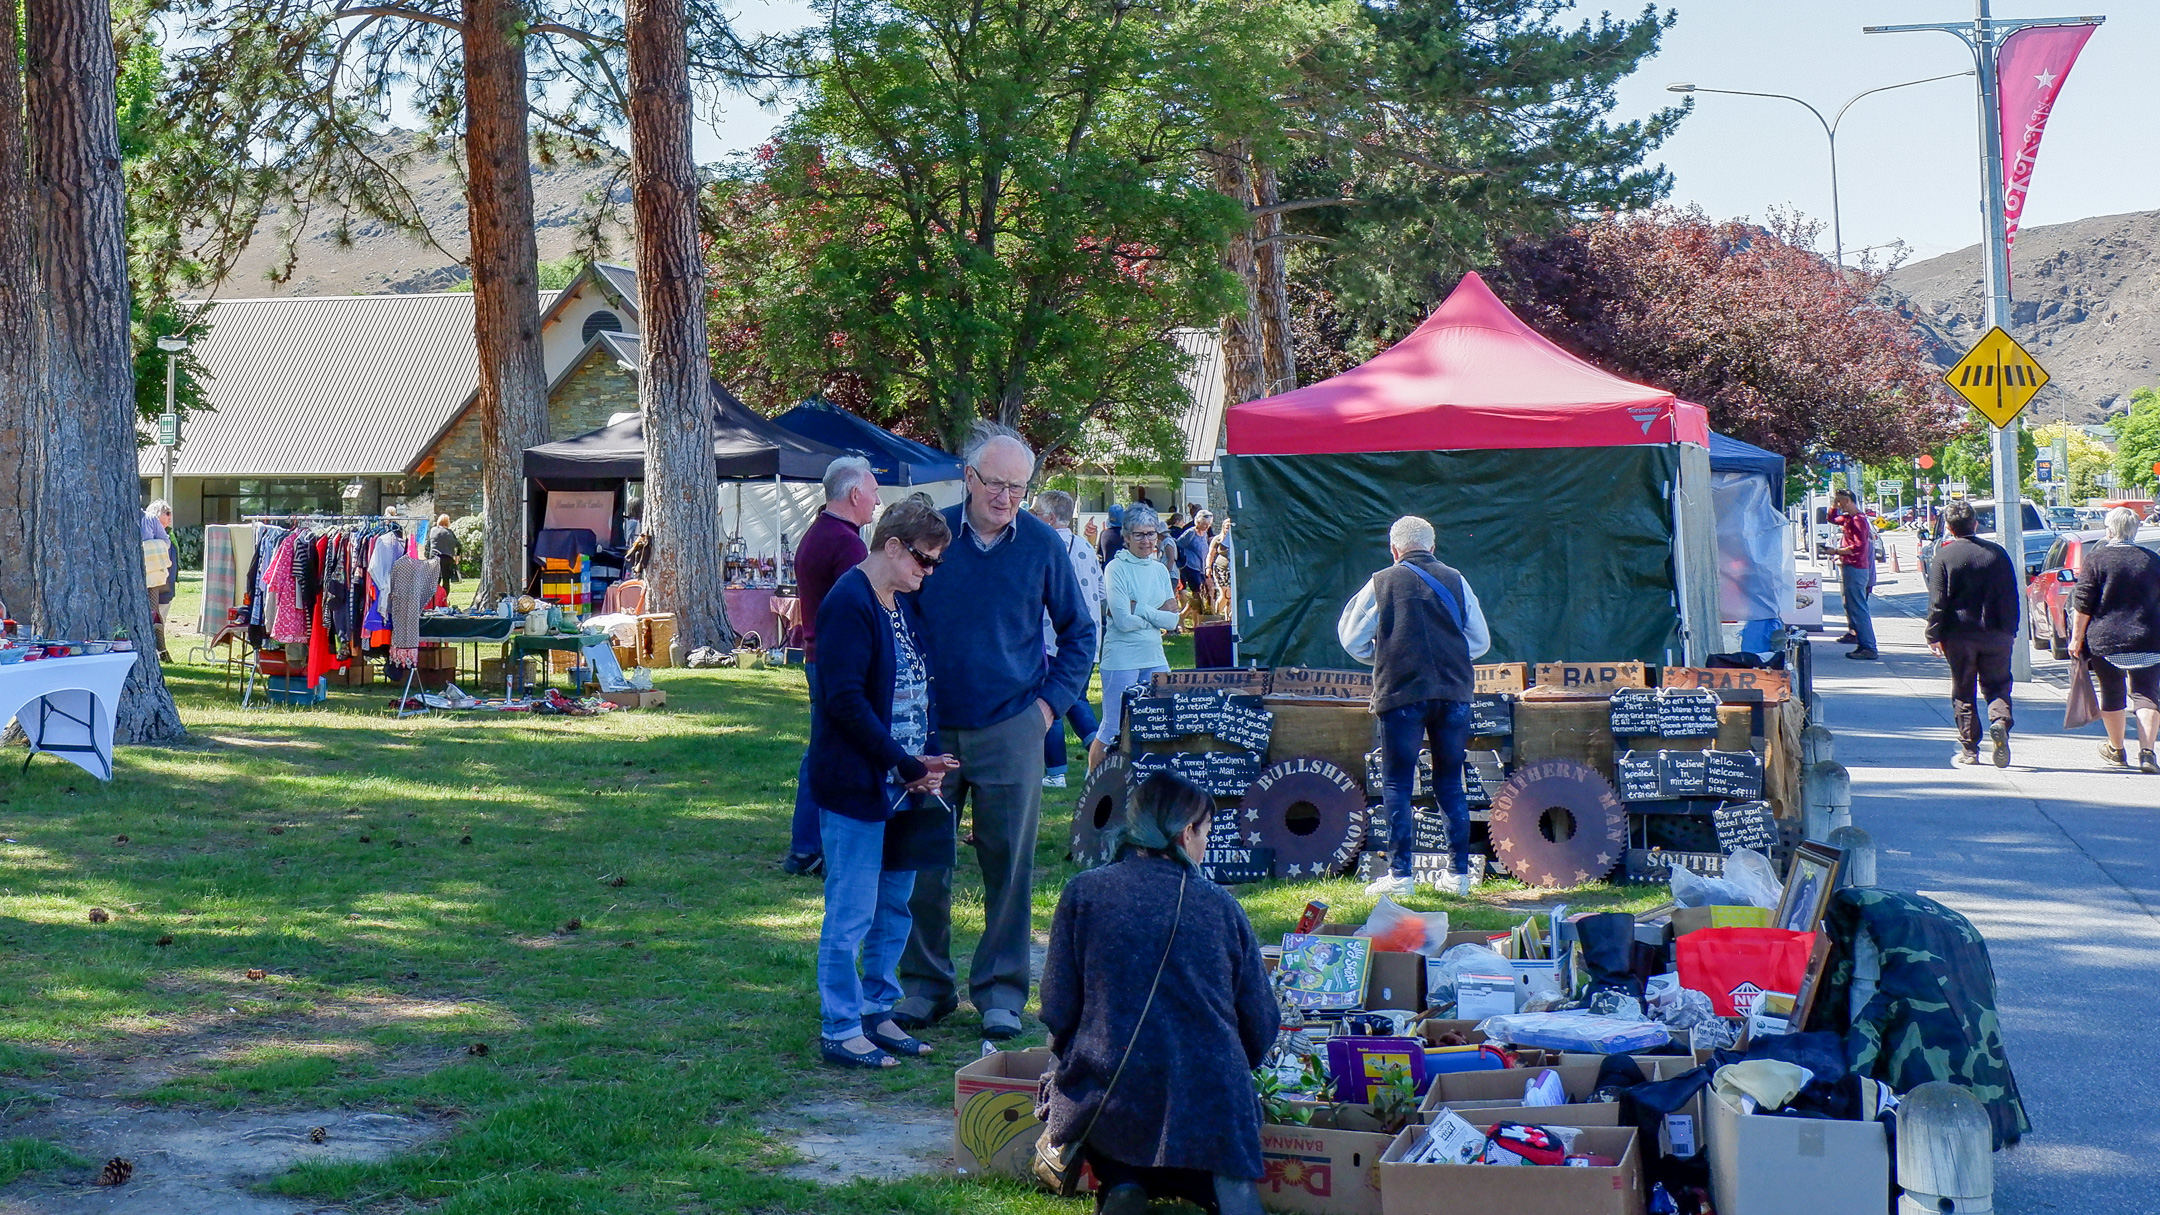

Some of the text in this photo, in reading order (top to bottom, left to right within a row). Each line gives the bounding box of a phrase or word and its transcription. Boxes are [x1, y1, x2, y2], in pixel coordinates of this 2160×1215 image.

[1285, 670, 1373, 686] SOUTHER
[1563, 667, 1617, 688] BAR
[1697, 671, 1756, 690] BAR
[1191, 696, 1216, 705] enough
[1672, 697, 1684, 705] err
[1686, 696, 1694, 704] is
[1236, 705, 1243, 714] is
[1244, 708, 1256, 718] the
[1473, 710, 1483, 719] in
[1660, 706, 1670, 714] to
[1176, 712, 1220, 723] young enoug
[1221, 712, 1235, 723] age
[1236, 716, 1246, 725] of
[1186, 723, 1205, 732] enjoy
[1229, 724, 1236, 732] is
[1236, 727, 1250, 736] the
[1611, 725, 1658, 733] remember it
[1216, 732, 1227, 740] of
[1183, 760, 1205, 770] money
[1636, 760, 1651, 768] not
[1667, 759, 1704, 768] I believe
[1257, 758, 1356, 793] BULLSHIT
[1680, 769, 1690, 778] in
[1208, 779, 1214, 787] a
[1217, 779, 1234, 787] cut
[1639, 781, 1655, 789] well
[1213, 788, 1227, 796] the
[1229, 788, 1245, 796] rest
[1468, 785, 1482, 793] well
[1494, 762, 1589, 823] SOUTHERN
[1708, 785, 1728, 793] piss
[1598, 791, 1622, 843] MAN
[1732, 810, 1743, 818] on
[1744, 806, 1763, 819] your
[1715, 816, 1764, 829] steel horse
[1419, 830, 1445, 843] forgot
[1719, 824, 1765, 838] and go find
[1332, 810, 1364, 865] ZONE
[1720, 830, 1772, 847] your soul in
[1419, 841, 1433, 849] was
[1646, 852, 1728, 872] SOUTH
[1343, 940, 1366, 989] Silly Sketch
